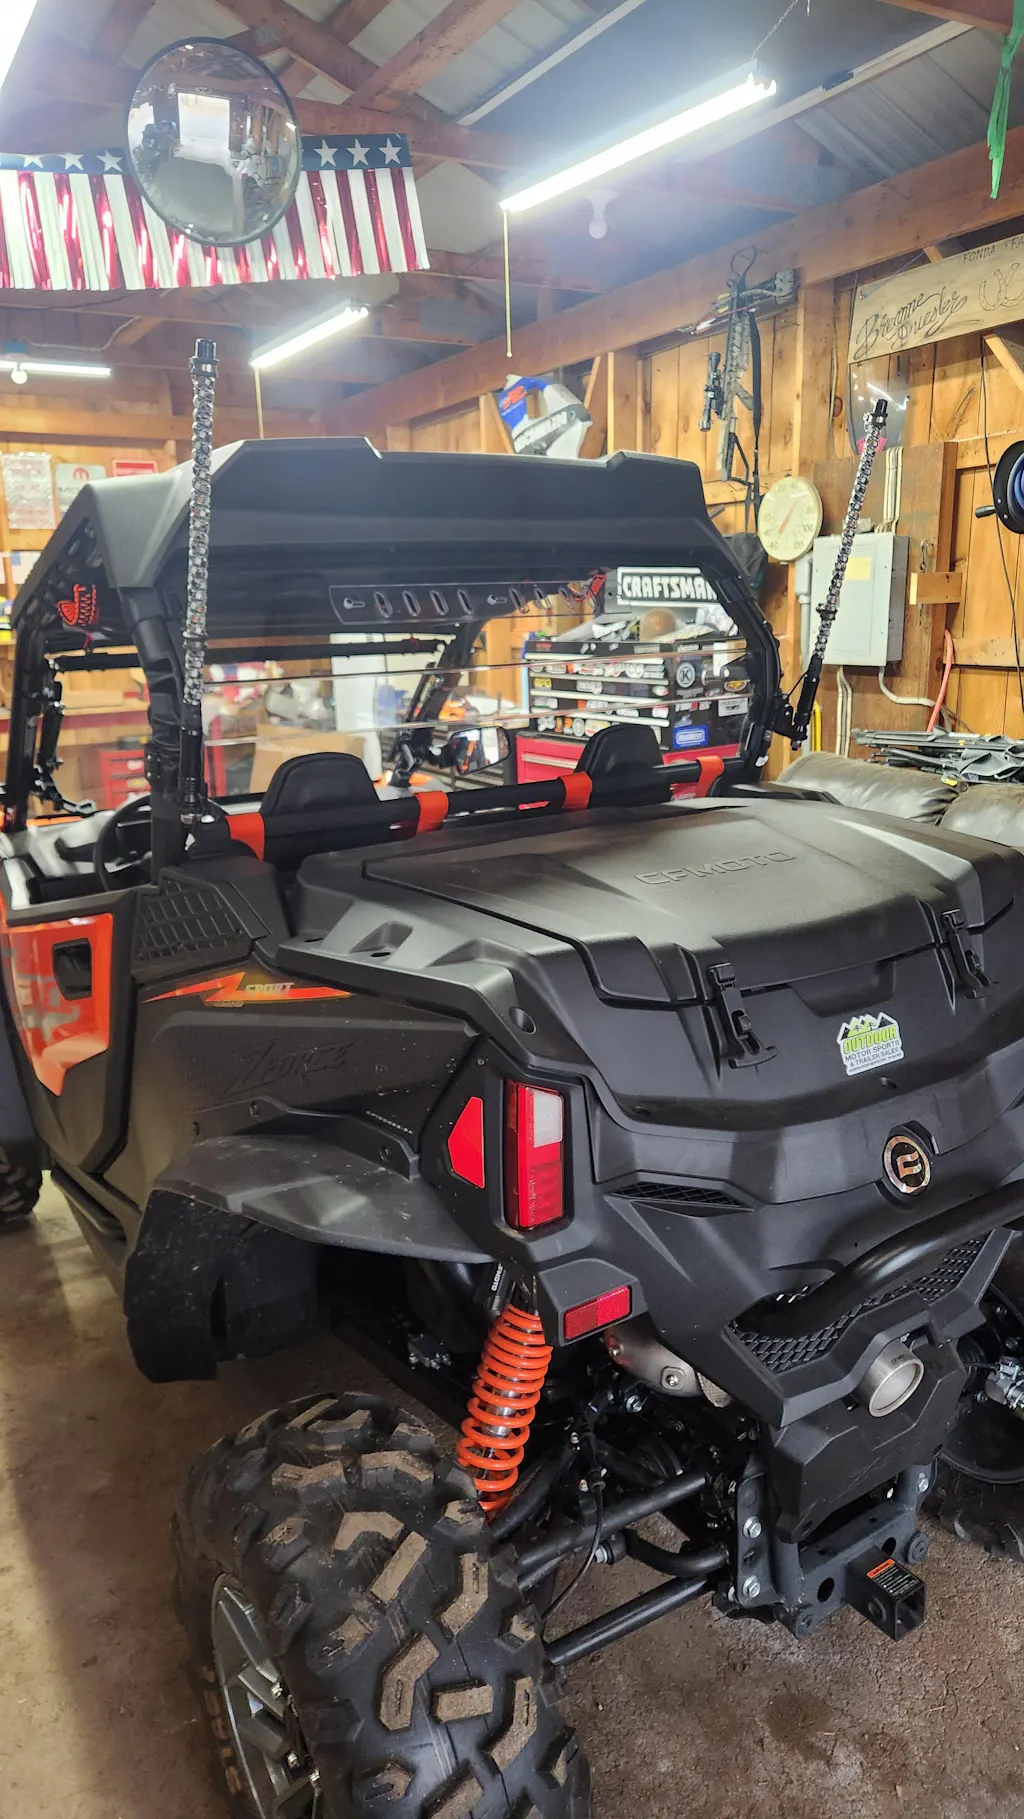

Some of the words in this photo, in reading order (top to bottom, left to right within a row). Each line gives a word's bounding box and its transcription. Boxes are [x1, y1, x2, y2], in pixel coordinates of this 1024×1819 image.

[635, 852, 796, 885] CFMOTO
[843, 1025, 898, 1054] OUTDOOR
[845, 1049, 872, 1062] MOTOR
[872, 1039, 900, 1054] SPORTS
[855, 1052, 880, 1066] TRAILER
[880, 1047, 899, 1058] SALES
